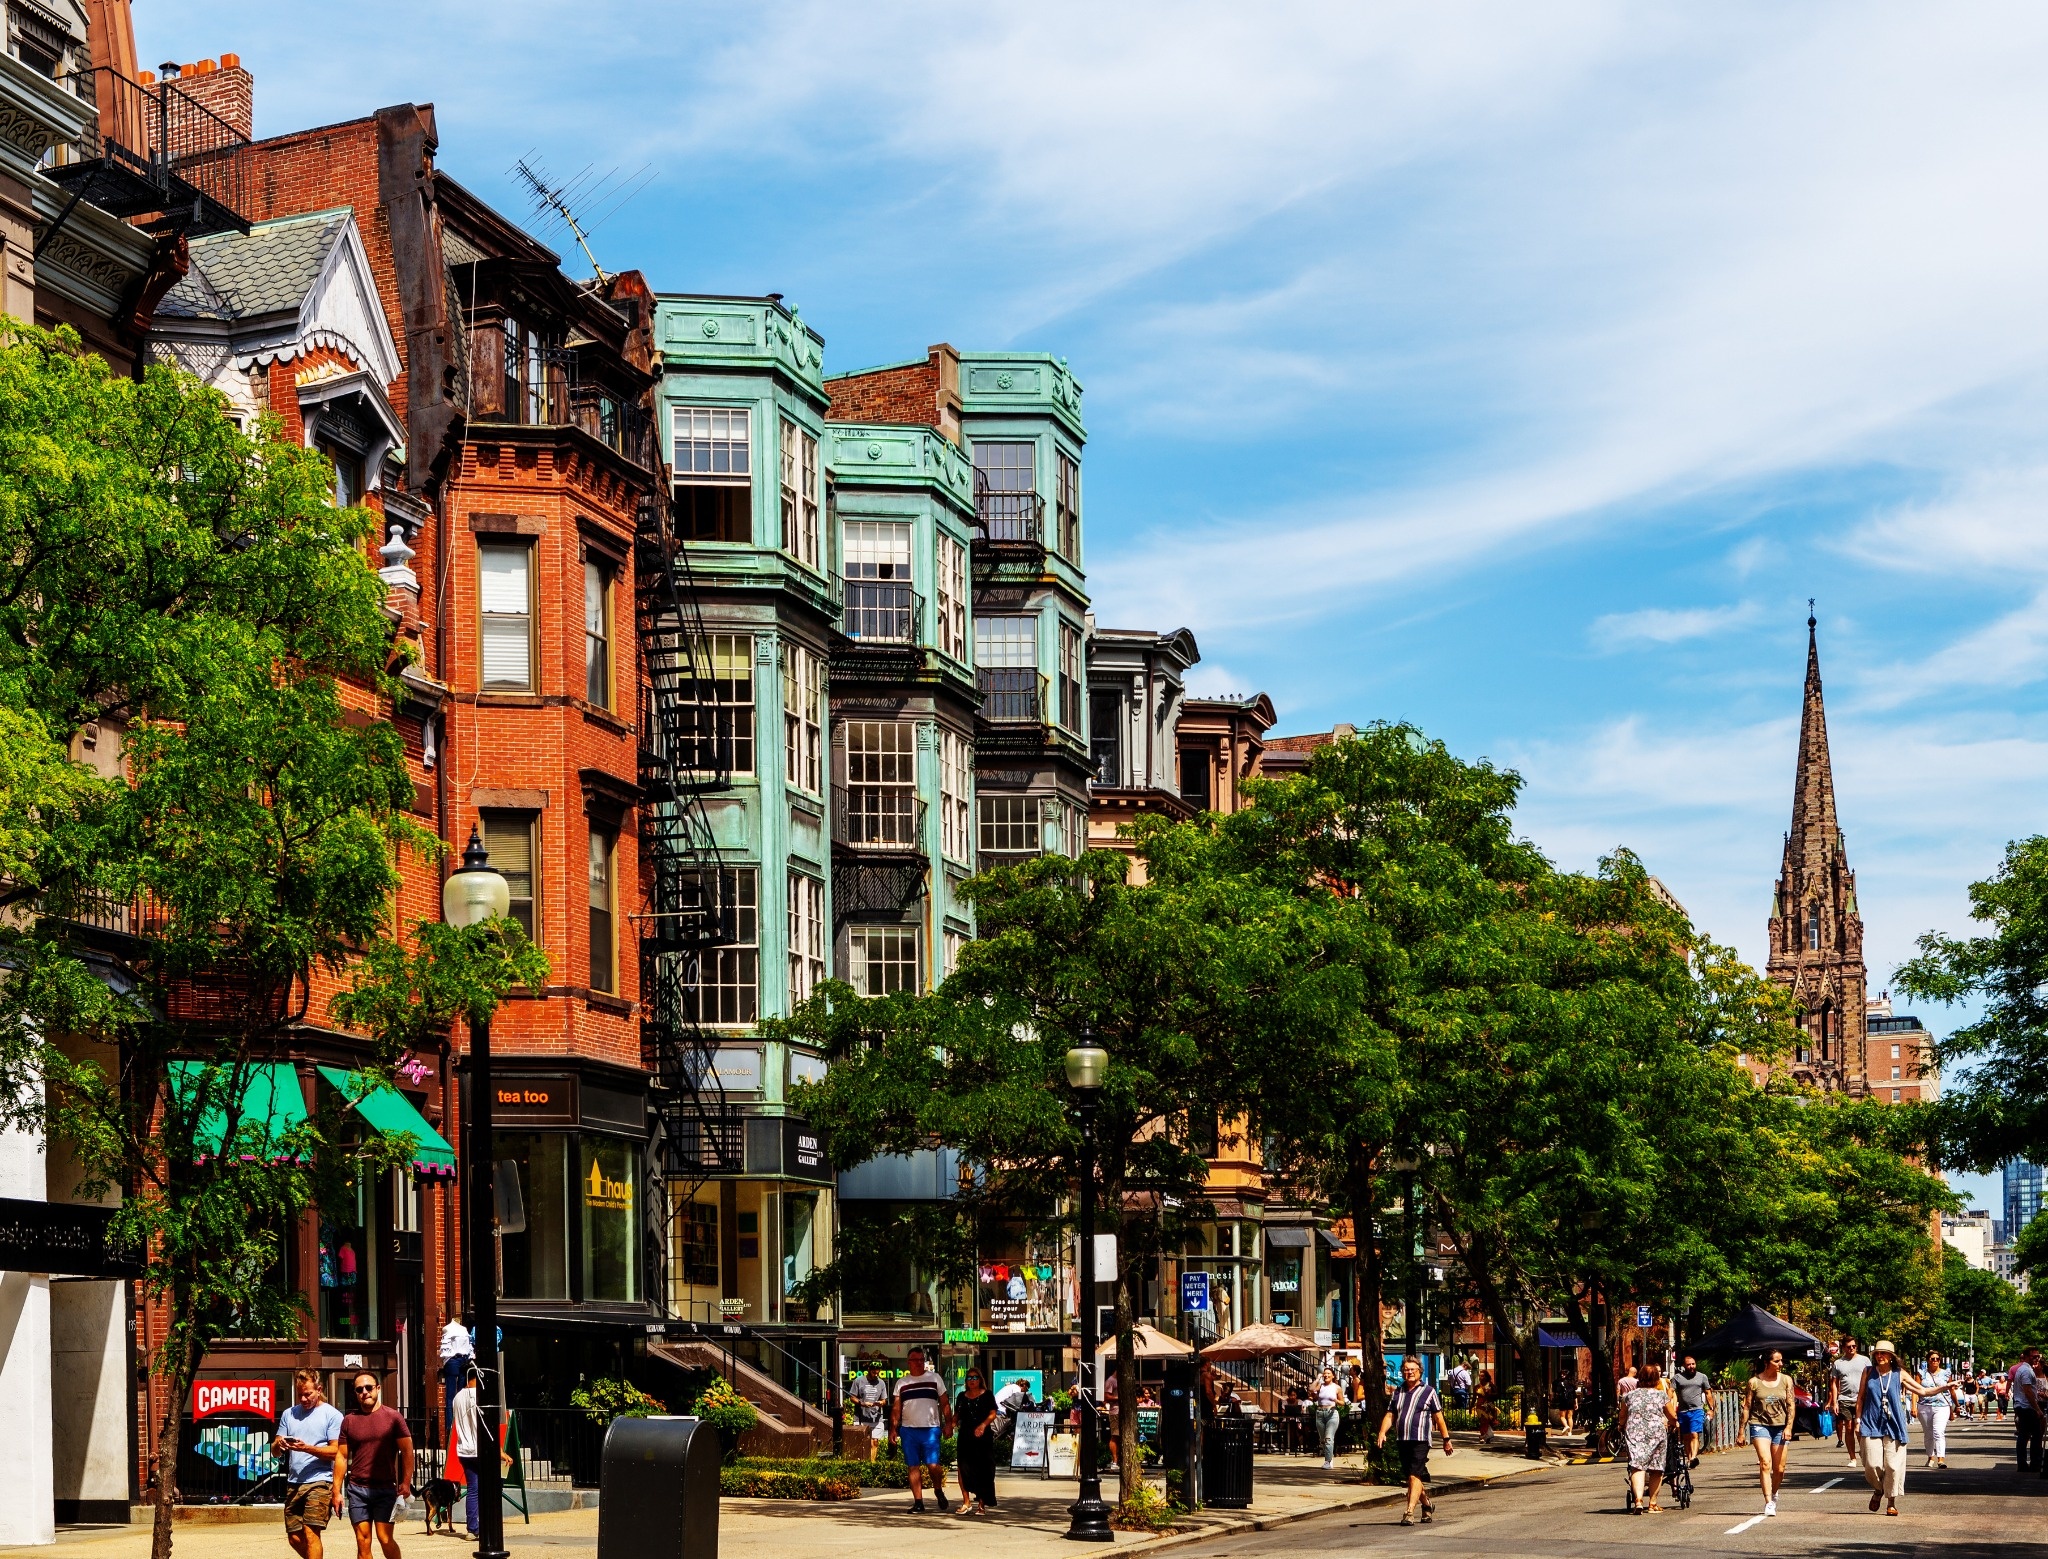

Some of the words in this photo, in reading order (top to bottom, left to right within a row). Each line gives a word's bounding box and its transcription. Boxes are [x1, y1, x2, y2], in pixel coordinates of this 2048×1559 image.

[498, 1090, 521, 1103] tea
[524, 1090, 549, 1104] too
[798, 1135, 818, 1150] ARDEN
[798, 1155, 818, 1166] GALLERY
[607, 1176, 632, 1200] haus
[1184, 1282, 1206, 1290] METER
[198, 1386, 270, 1413] CAMPER
